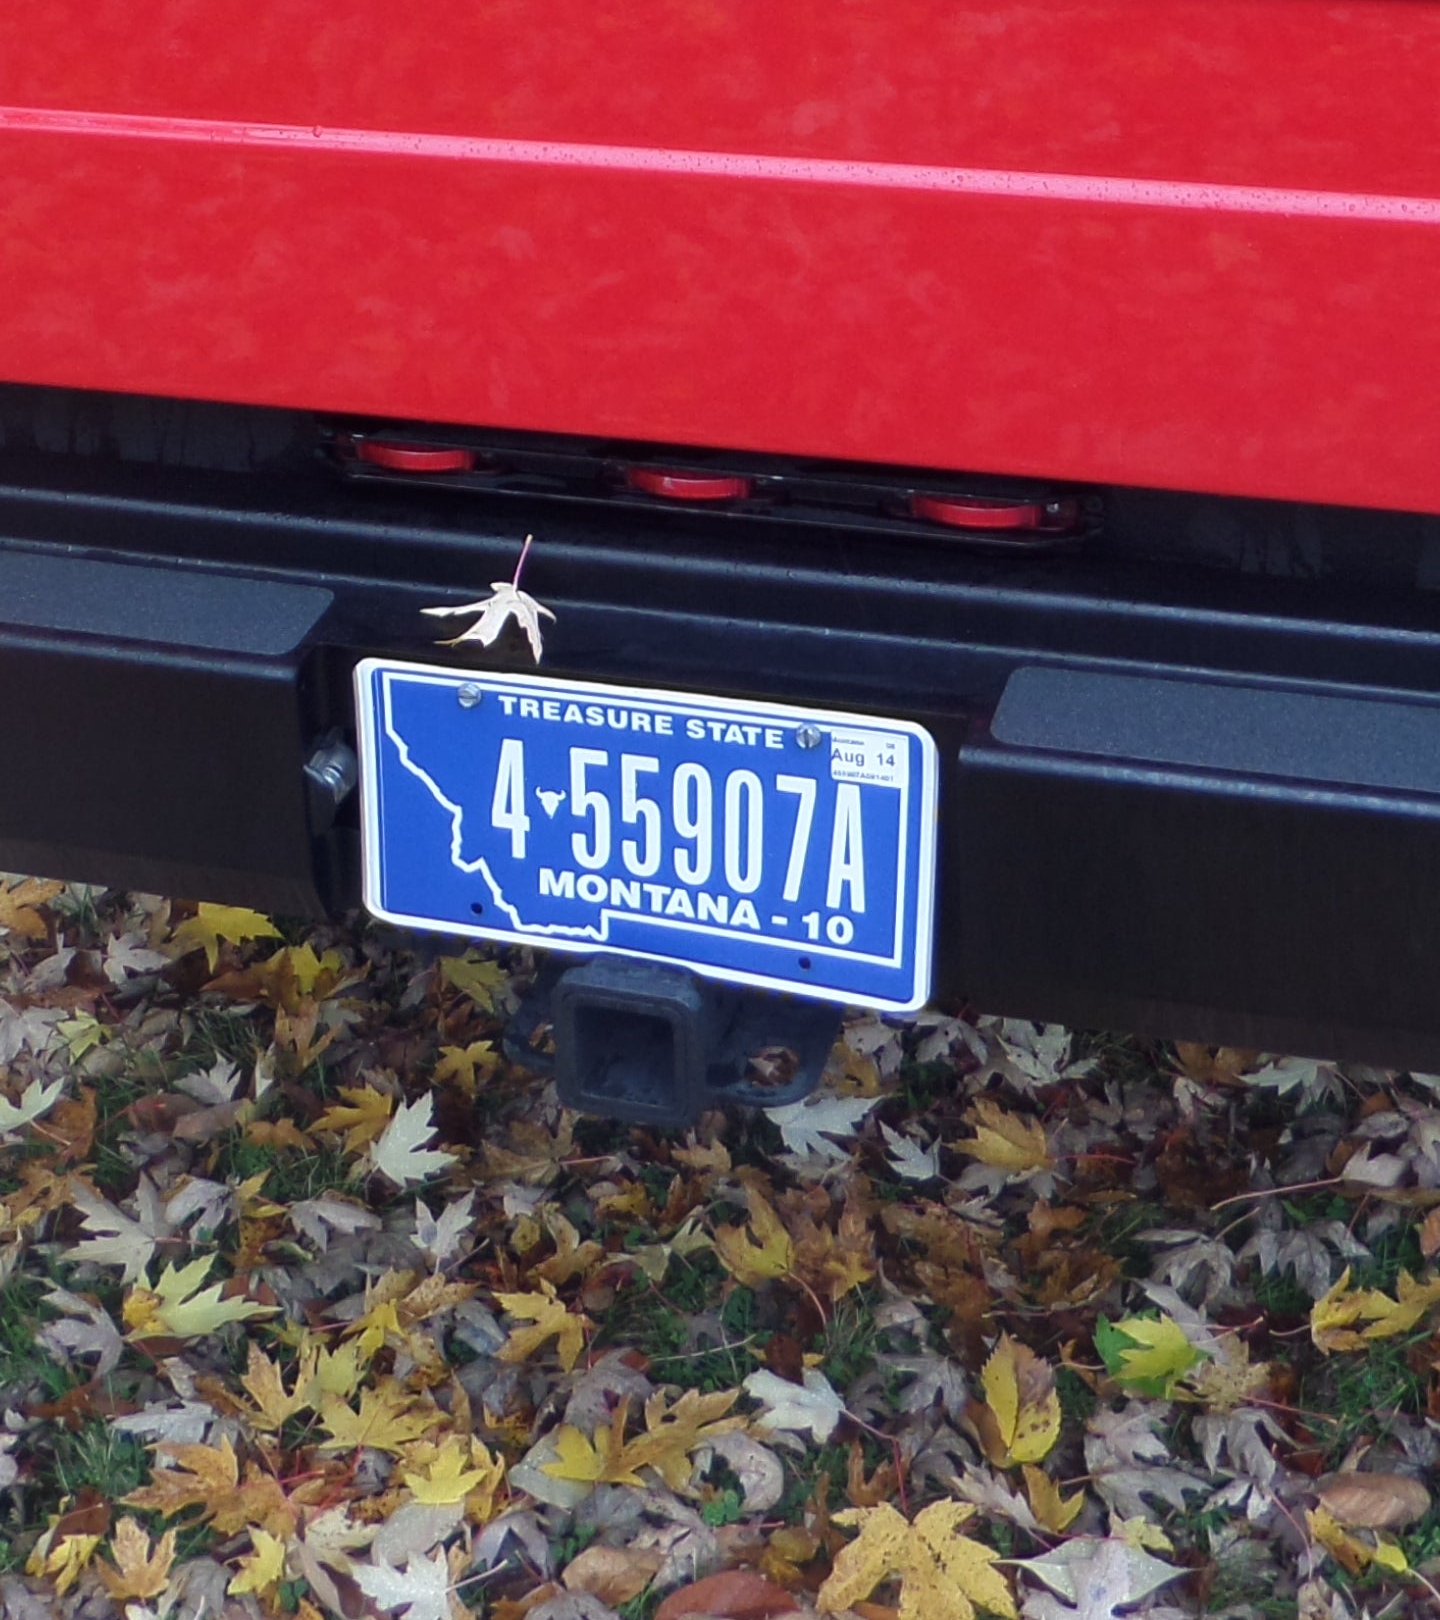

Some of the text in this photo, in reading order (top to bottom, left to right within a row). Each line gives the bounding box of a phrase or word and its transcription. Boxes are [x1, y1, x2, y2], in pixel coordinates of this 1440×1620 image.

[497, 694, 785, 750] TREASURE STATE
[831, 747, 896, 768] Aug 14
[538, 867, 761, 930] MONTANA
[801, 911, 855, 946] 10
